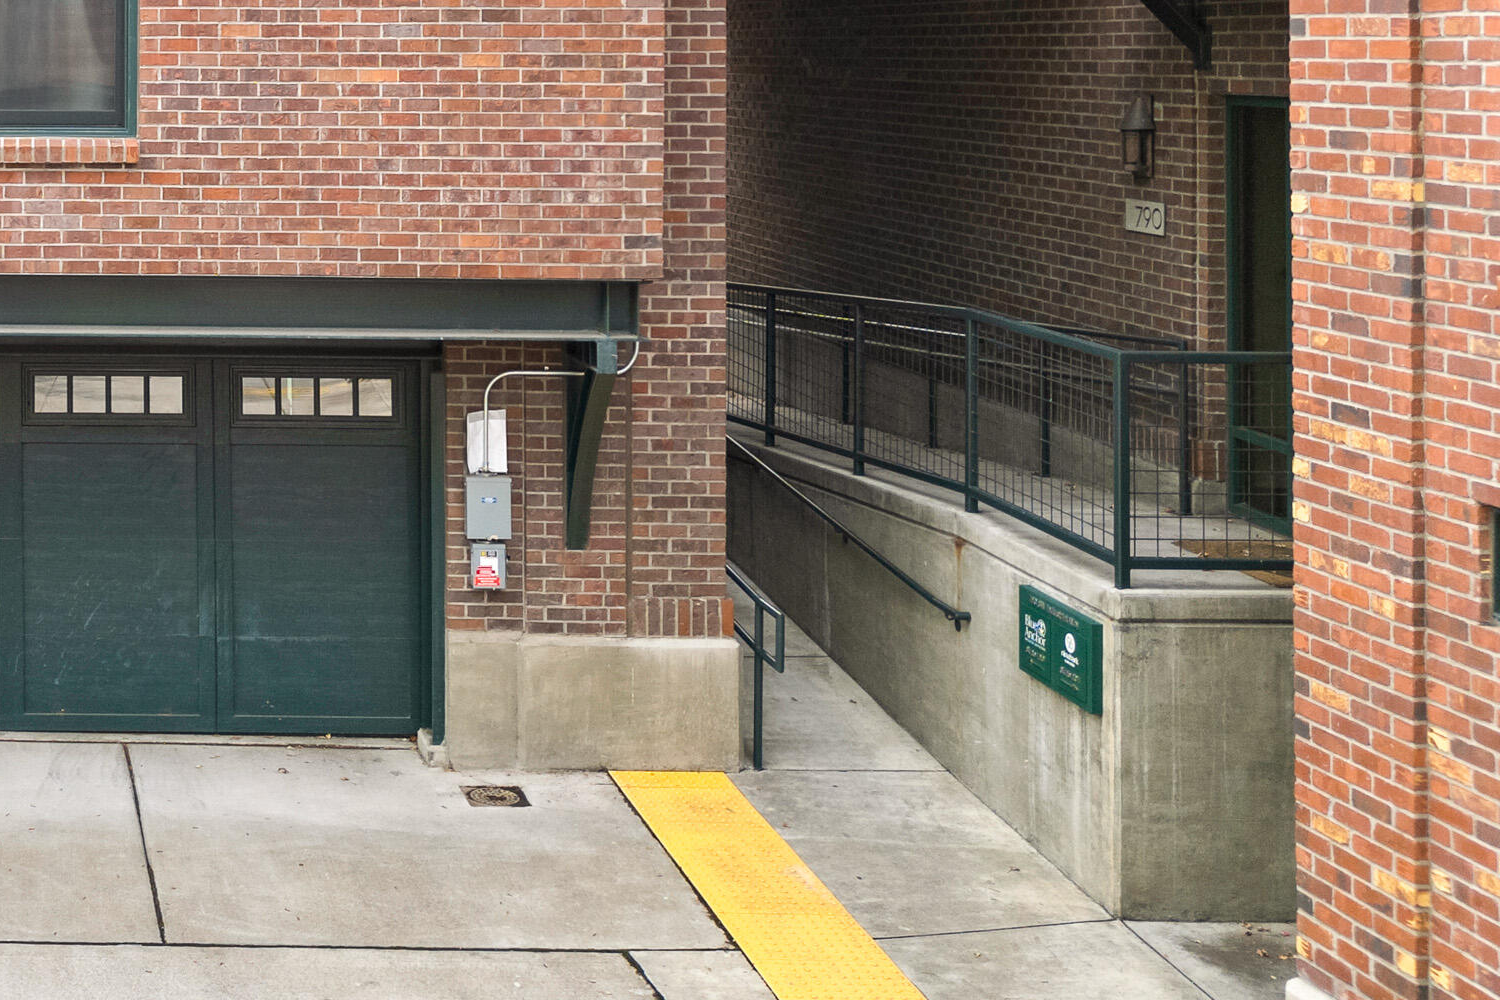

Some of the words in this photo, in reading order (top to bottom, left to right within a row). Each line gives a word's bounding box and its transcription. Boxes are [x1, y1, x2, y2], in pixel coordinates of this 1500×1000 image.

[1135, 205, 1162, 230] 790
[1025, 613, 1040, 630] Blue
[1025, 625, 1047, 647] Anchor
